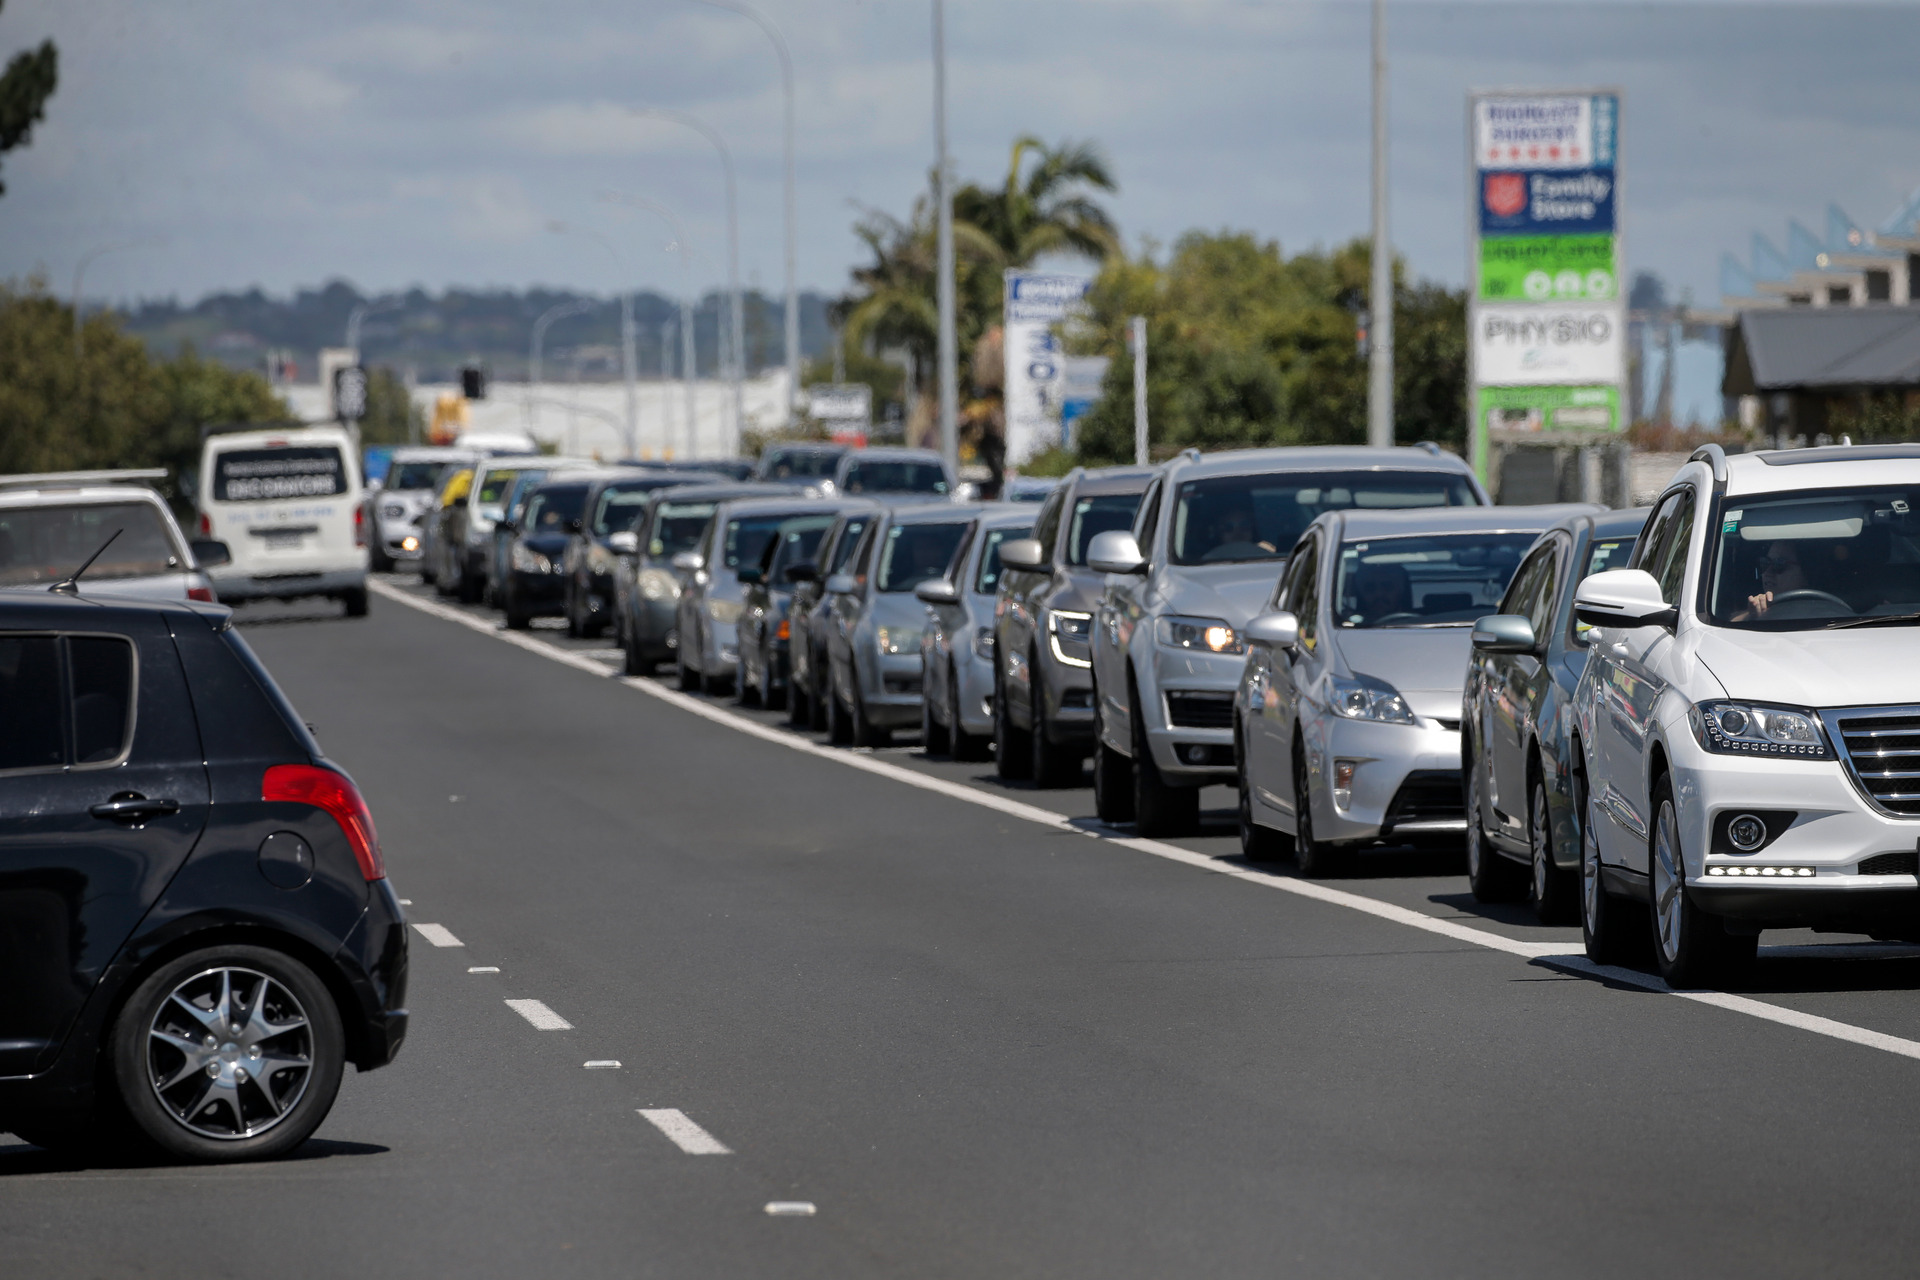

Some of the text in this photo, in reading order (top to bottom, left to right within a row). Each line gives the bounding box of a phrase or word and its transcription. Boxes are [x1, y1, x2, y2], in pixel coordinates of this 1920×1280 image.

[1532, 174, 1610, 201] Family
[1532, 198, 1596, 221] Store
[1485, 316, 1610, 346] PHYSIO
